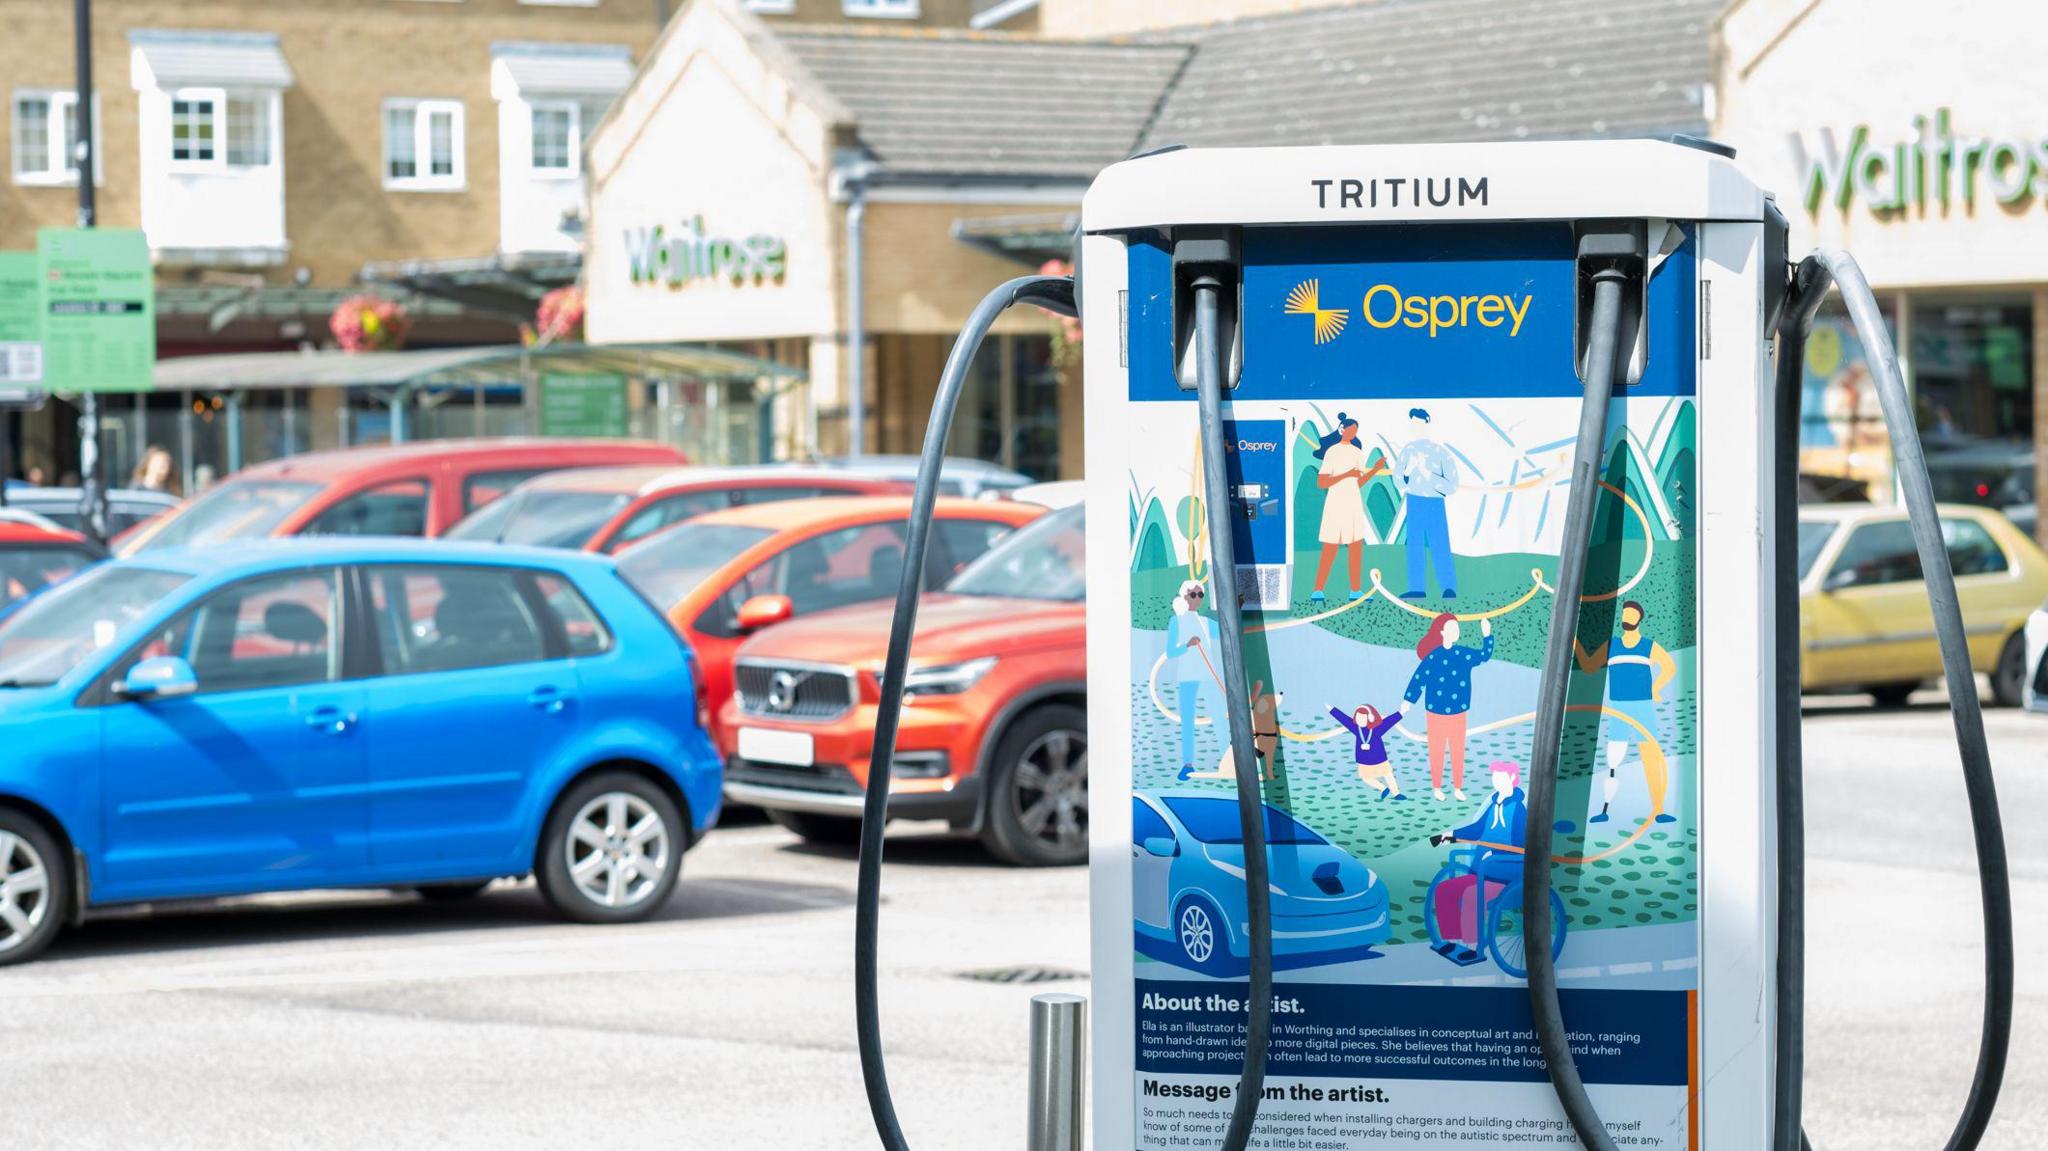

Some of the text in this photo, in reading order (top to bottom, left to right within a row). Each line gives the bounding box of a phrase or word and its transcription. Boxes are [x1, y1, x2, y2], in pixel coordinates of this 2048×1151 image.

[1311, 177, 1489, 209] TRITIUM
[623, 214, 788, 290] Waitrose
[1362, 284, 1533, 338] Osprey
[1238, 440, 1277, 452] Osprey
[1142, 993, 1305, 1013] About the aist.
[1142, 1021, 1156, 1031] Ella
[1160, 1021, 1168, 1031] is
[1170, 1023, 1182, 1032] an
[1186, 1021, 1235, 1032] illustrator
[1272, 1024, 1282, 1034] in
[1285, 1024, 1333, 1037] Worthing
[1336, 1026, 1356, 1036] and
[1358, 1026, 1416, 1038] specialises
[1419, 1027, 1429, 1037] in
[1432, 1028, 1492, 1040] conceptual
[1494, 1030, 1510, 1039] art
[1512, 1029, 1533, 1040] and
[1598, 1032, 1641, 1044] ranging
[1142, 1034, 1164, 1044] from
[1166, 1034, 1228, 1046] hand-drawn
[1231, 1037, 1247, 1046] ide
[1275, 1040, 1302, 1048] more
[1305, 1039, 1338, 1050] digital
[1341, 1040, 1379, 1051] pieces.
[1382, 1040, 1402, 1050] She
[1405, 1040, 1449, 1051] believes
[1452, 1042, 1472, 1052] that
[1476, 1042, 1512, 1054] having
[1514, 1045, 1528, 1053] an
[1571, 1044, 1588, 1054] ind
[1591, 1045, 1621, 1055] when
[1142, 1049, 1204, 1061] approaching
[1274, 1051, 1302, 1061] often
[1305, 1052, 1328, 1062] lead
[1330, 1054, 1341, 1062] to
[1344, 1054, 1372, 1063] more
[1374, 1054, 1430, 1065] successful
[1434, 1056, 1487, 1066] outcomes
[1490, 1056, 1500, 1066] in
[1502, 1056, 1520, 1067] the
[1523, 1057, 1547, 1070] long
[1143, 1079, 1231, 1102] Message
[1290, 1084, 1324, 1101] the
[1328, 1084, 1389, 1103] artist.
[1143, 1107, 1154, 1117] So
[1156, 1108, 1186, 1118] much
[1189, 1109, 1220, 1120] needs
[1222, 1110, 1232, 1120] to
[1254, 1112, 1310, 1122] considered
[1314, 1112, 1343, 1122] when
[1346, 1113, 1393, 1126] installing
[1396, 1115, 1443, 1127] chargers
[1446, 1116, 1466, 1126] and
[1468, 1116, 1512, 1129] building
[1516, 1118, 1563, 1130] charging
[1606, 1120, 1641, 1132] myself
[1144, 1121, 1167, 1132] know
[1170, 1122, 1181, 1132] of
[1184, 1124, 1212, 1133] some
[1214, 1123, 1225, 1133] of
[1308, 1126, 1337, 1136] faced
[1340, 1127, 1388, 1138] everyday
[1390, 1128, 1420, 1140] being
[1424, 1130, 1437, 1139] on
[1440, 1130, 1458, 1140] the
[1460, 1130, 1500, 1141] autistic
[1502, 1132, 1554, 1142] spectrum
[1556, 1133, 1576, 1143] and
[1640, 1137, 1664, 1146] any-
[1144, 1135, 1166, 1146] thing
[1170, 1136, 1190, 1146] that
[1193, 1138, 1212, 1146] can
[1248, 1138, 1261, 1148] ife
[1264, 1140, 1270, 1148] a
[1272, 1138, 1296, 1149] little
[1298, 1139, 1312, 1149] bit
[1315, 1140, 1349, 1150] easier.
